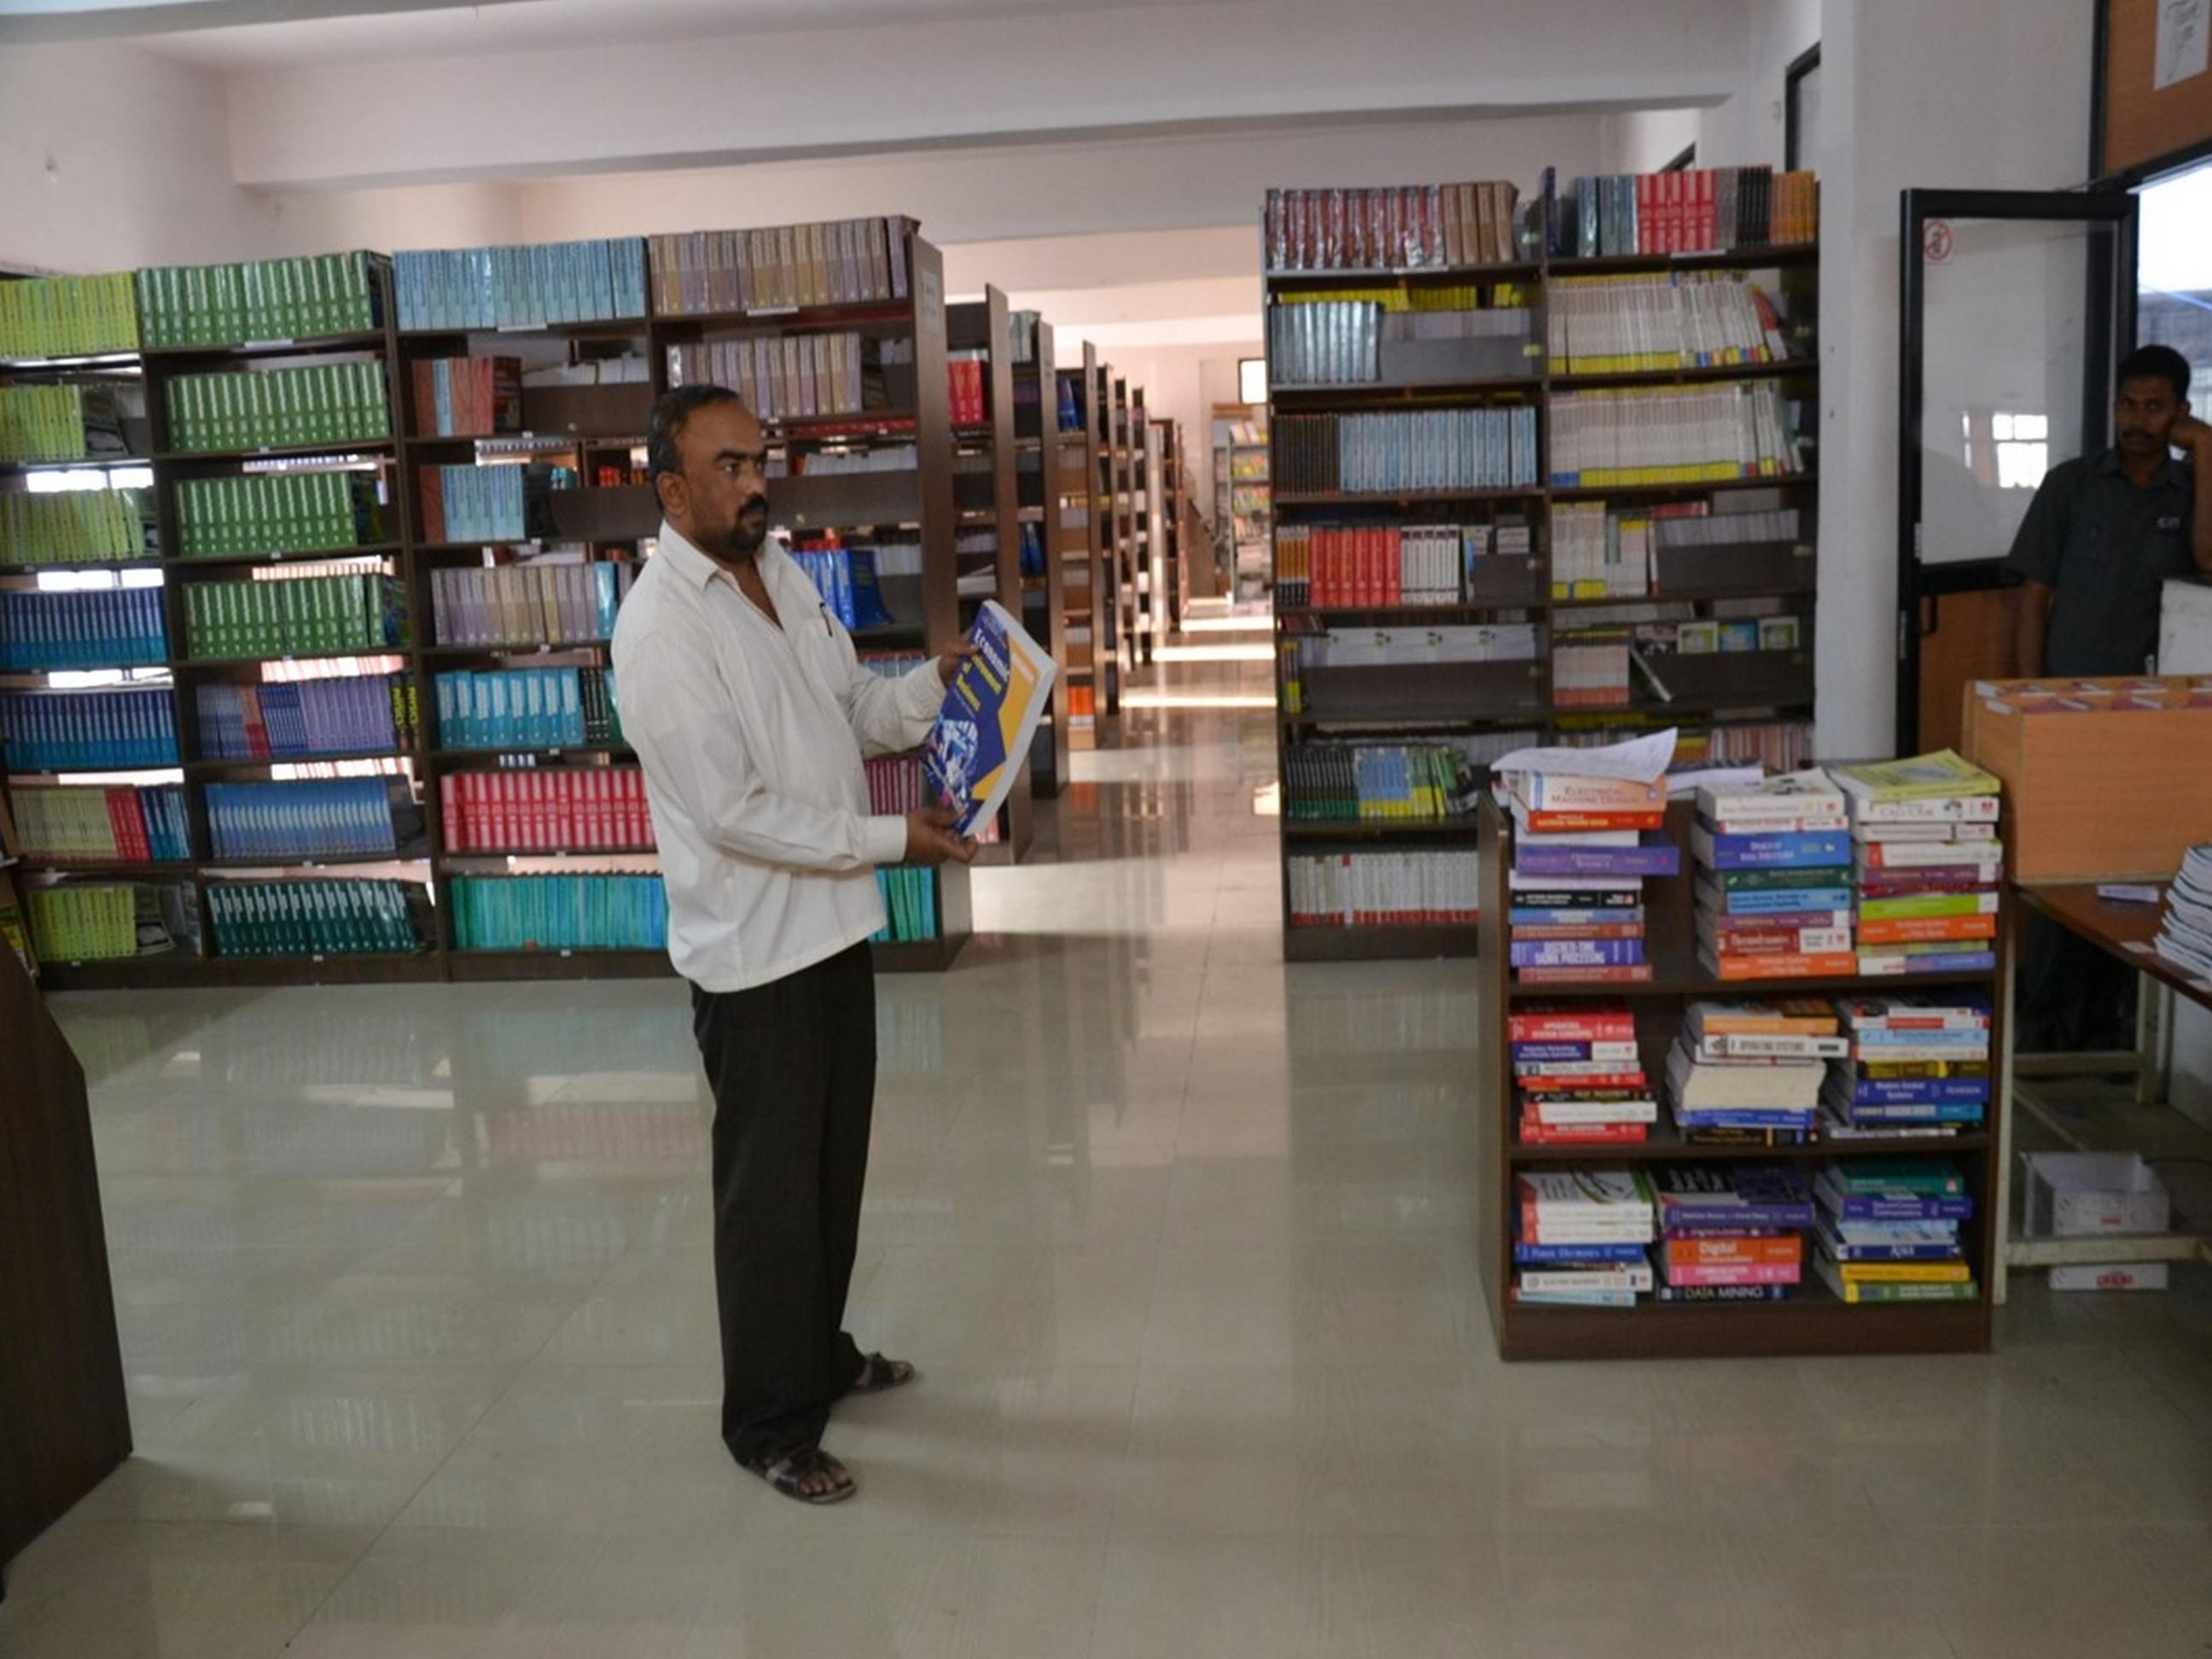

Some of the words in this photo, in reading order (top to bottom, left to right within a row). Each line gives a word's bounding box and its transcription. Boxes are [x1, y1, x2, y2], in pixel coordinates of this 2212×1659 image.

[1698, 1241, 1738, 1256] Digital
[1685, 1286, 1715, 1298] DATA
[1717, 1286, 1765, 1299] MINING
